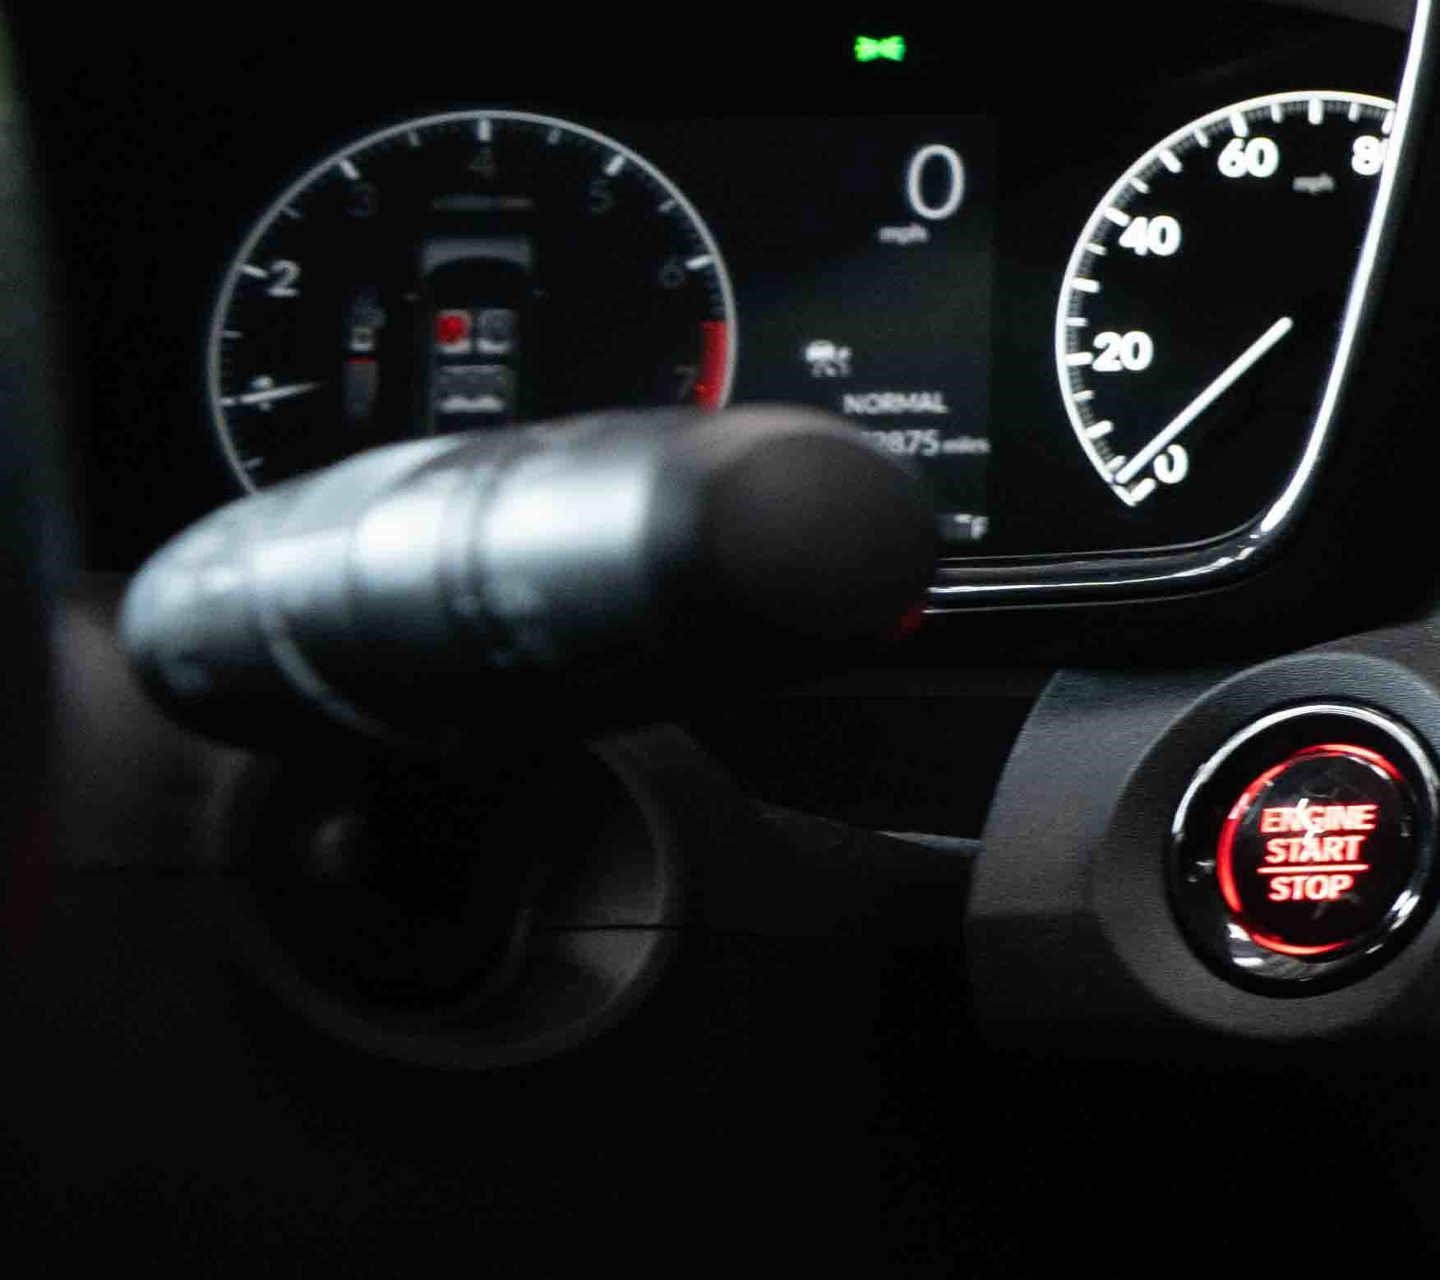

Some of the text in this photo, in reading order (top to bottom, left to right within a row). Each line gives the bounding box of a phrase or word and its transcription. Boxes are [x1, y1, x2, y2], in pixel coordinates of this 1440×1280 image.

[1217, 136, 1279, 179] 60
[907, 144, 966, 220] 0
[1119, 214, 1182, 257] 40
[266, 259, 302, 299] 2
[1091, 330, 1154, 372] 20
[842, 391, 951, 416] NORMAL
[1260, 804, 1379, 834] ENGINE
[1264, 835, 1367, 864] START
[1268, 874, 1354, 901] STOP
